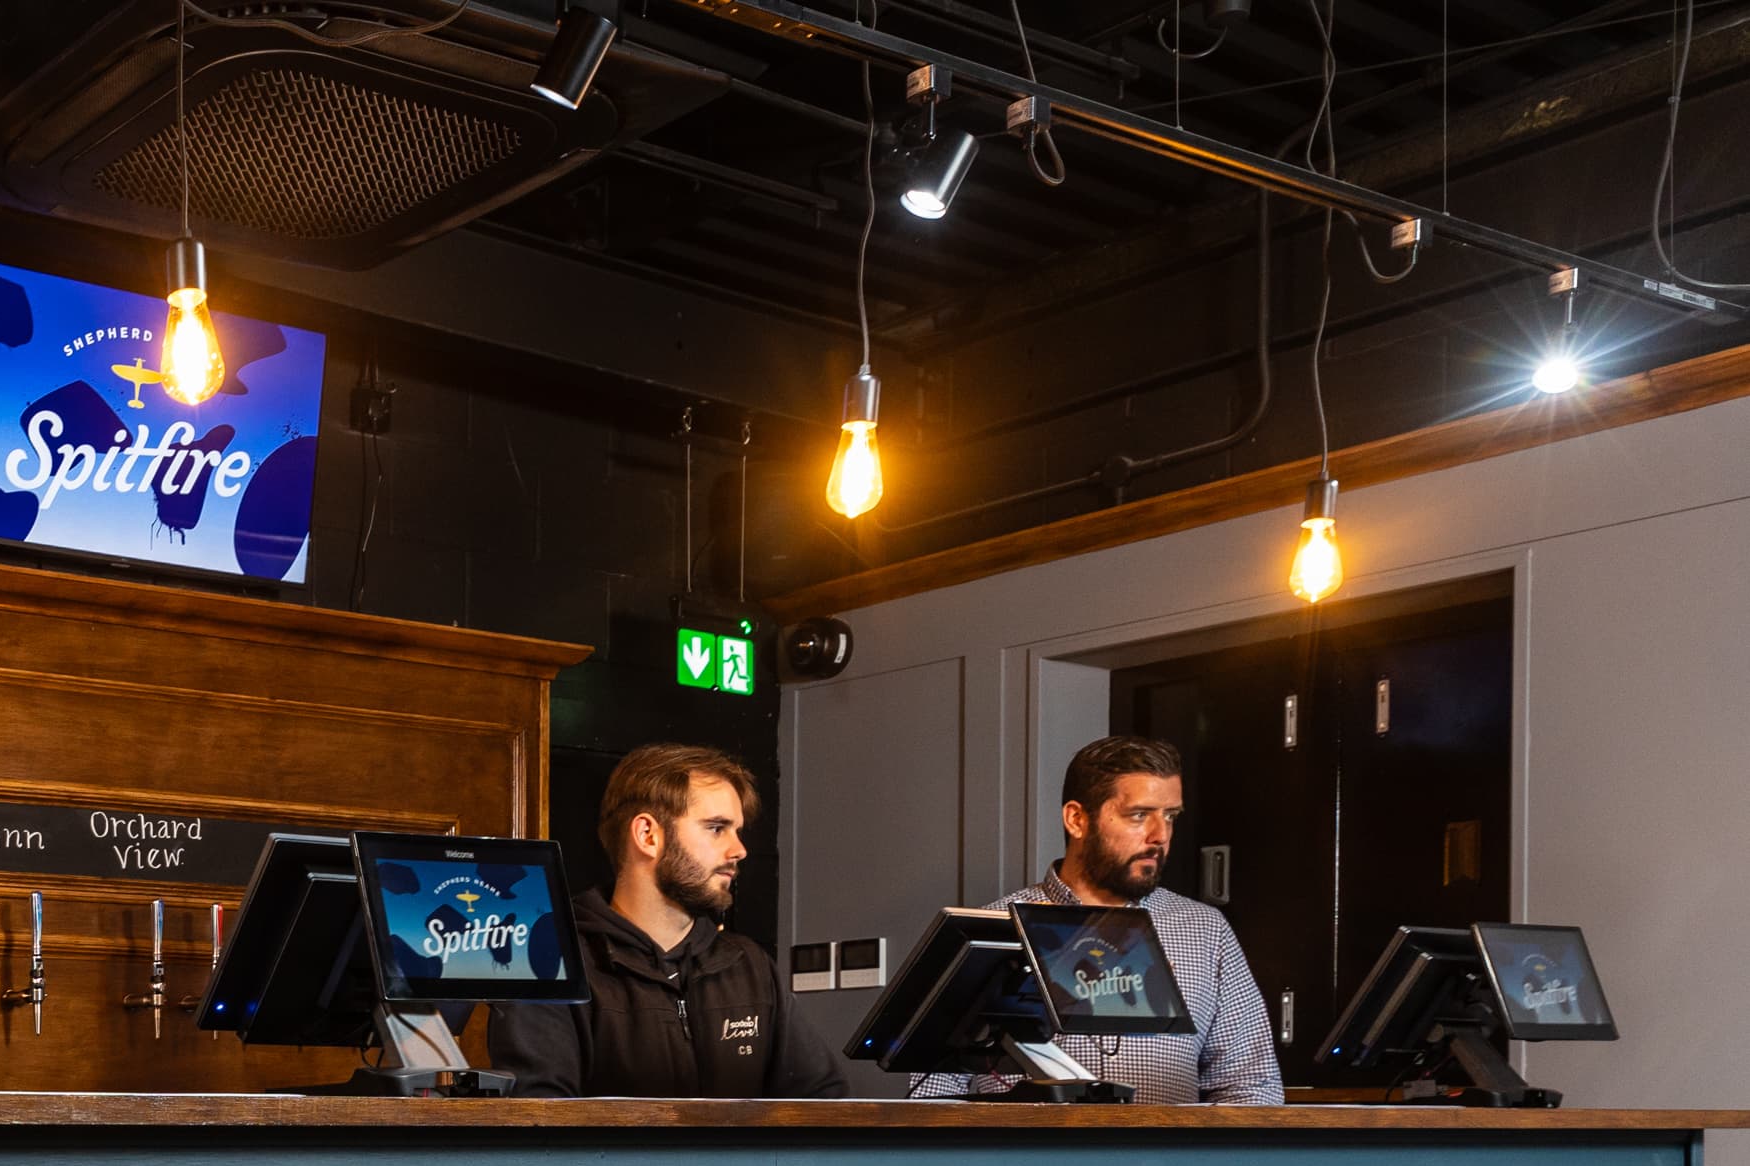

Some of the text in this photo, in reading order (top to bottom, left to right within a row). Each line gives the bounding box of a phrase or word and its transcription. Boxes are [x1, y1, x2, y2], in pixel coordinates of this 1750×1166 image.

[63, 326, 153, 357] SHEPHERD
[5, 410, 251, 510] Spitfire
[90, 811, 202, 842] Orchard
[423, 914, 528, 963] Spitfire
[1074, 966, 1145, 1004] Spitfire
